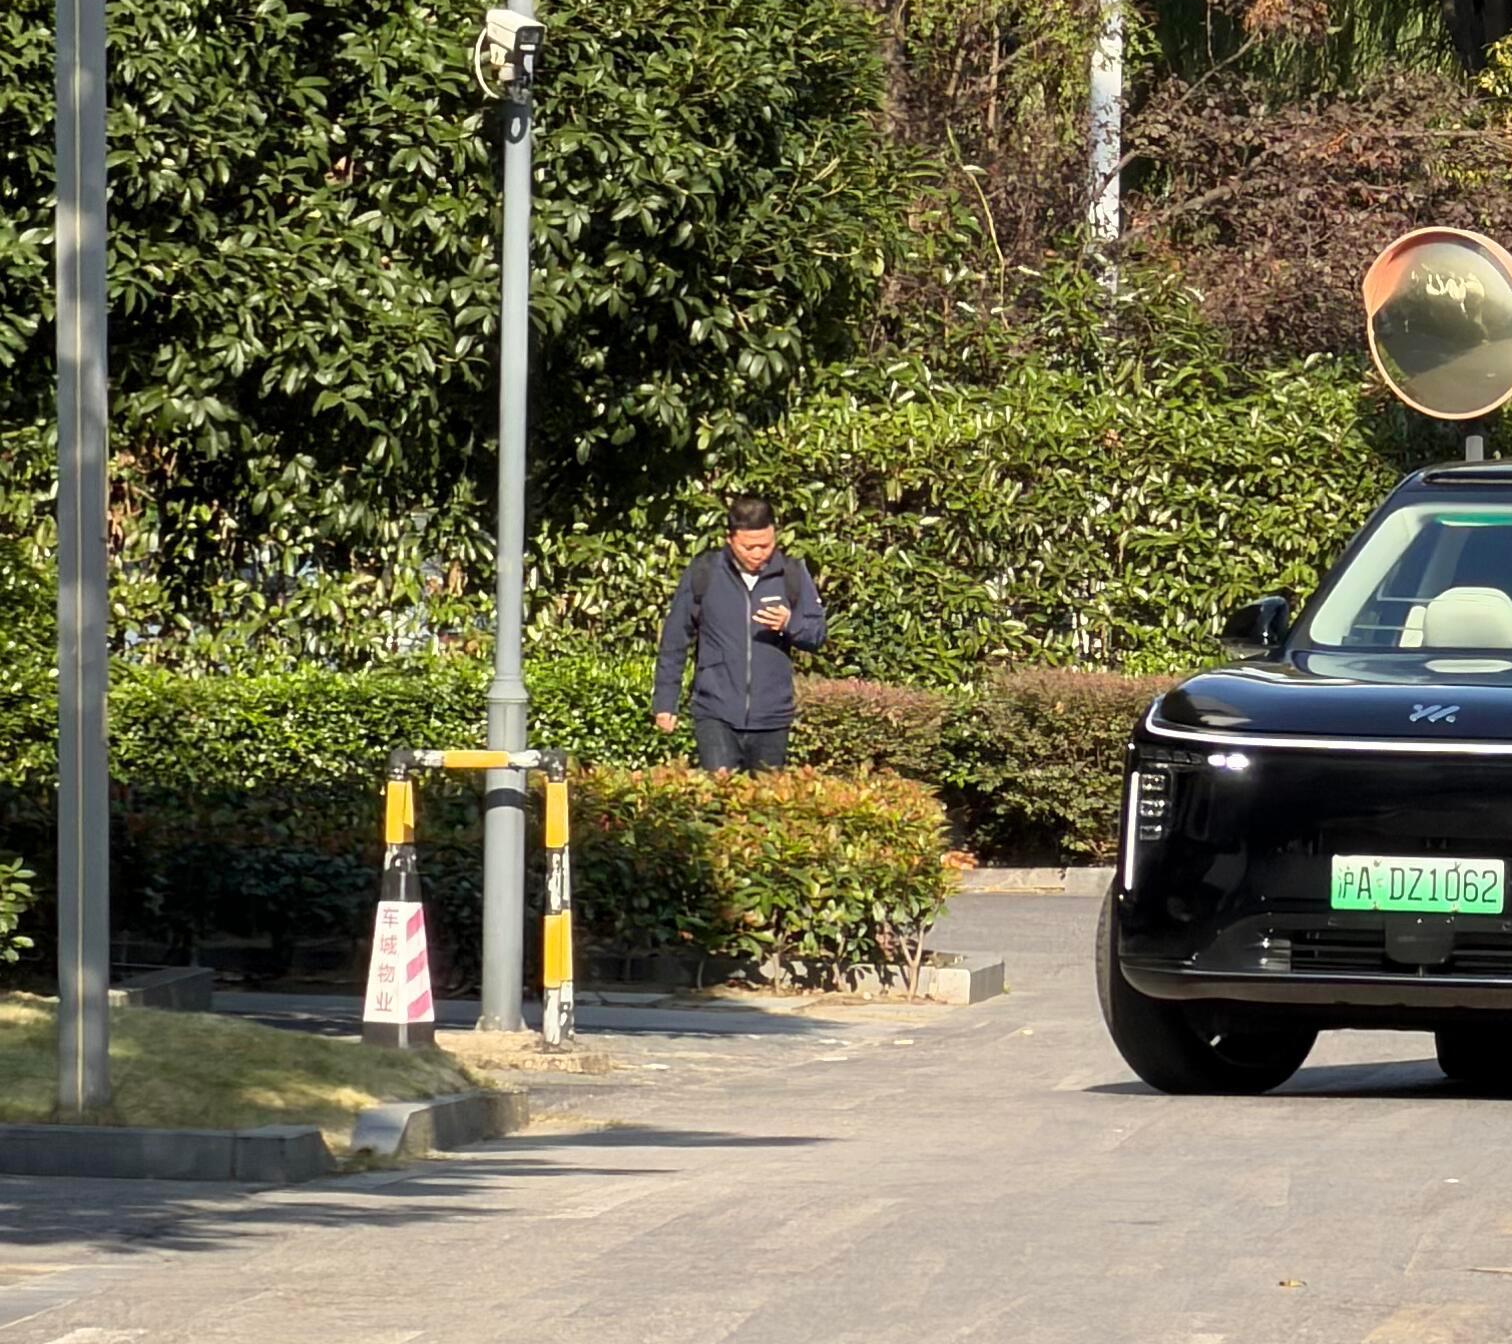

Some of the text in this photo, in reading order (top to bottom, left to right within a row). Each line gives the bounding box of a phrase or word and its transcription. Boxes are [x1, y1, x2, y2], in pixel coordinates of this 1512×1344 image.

[1389, 867, 1498, 903] DZ1062
[375, 907, 399, 1012] 车城物业
